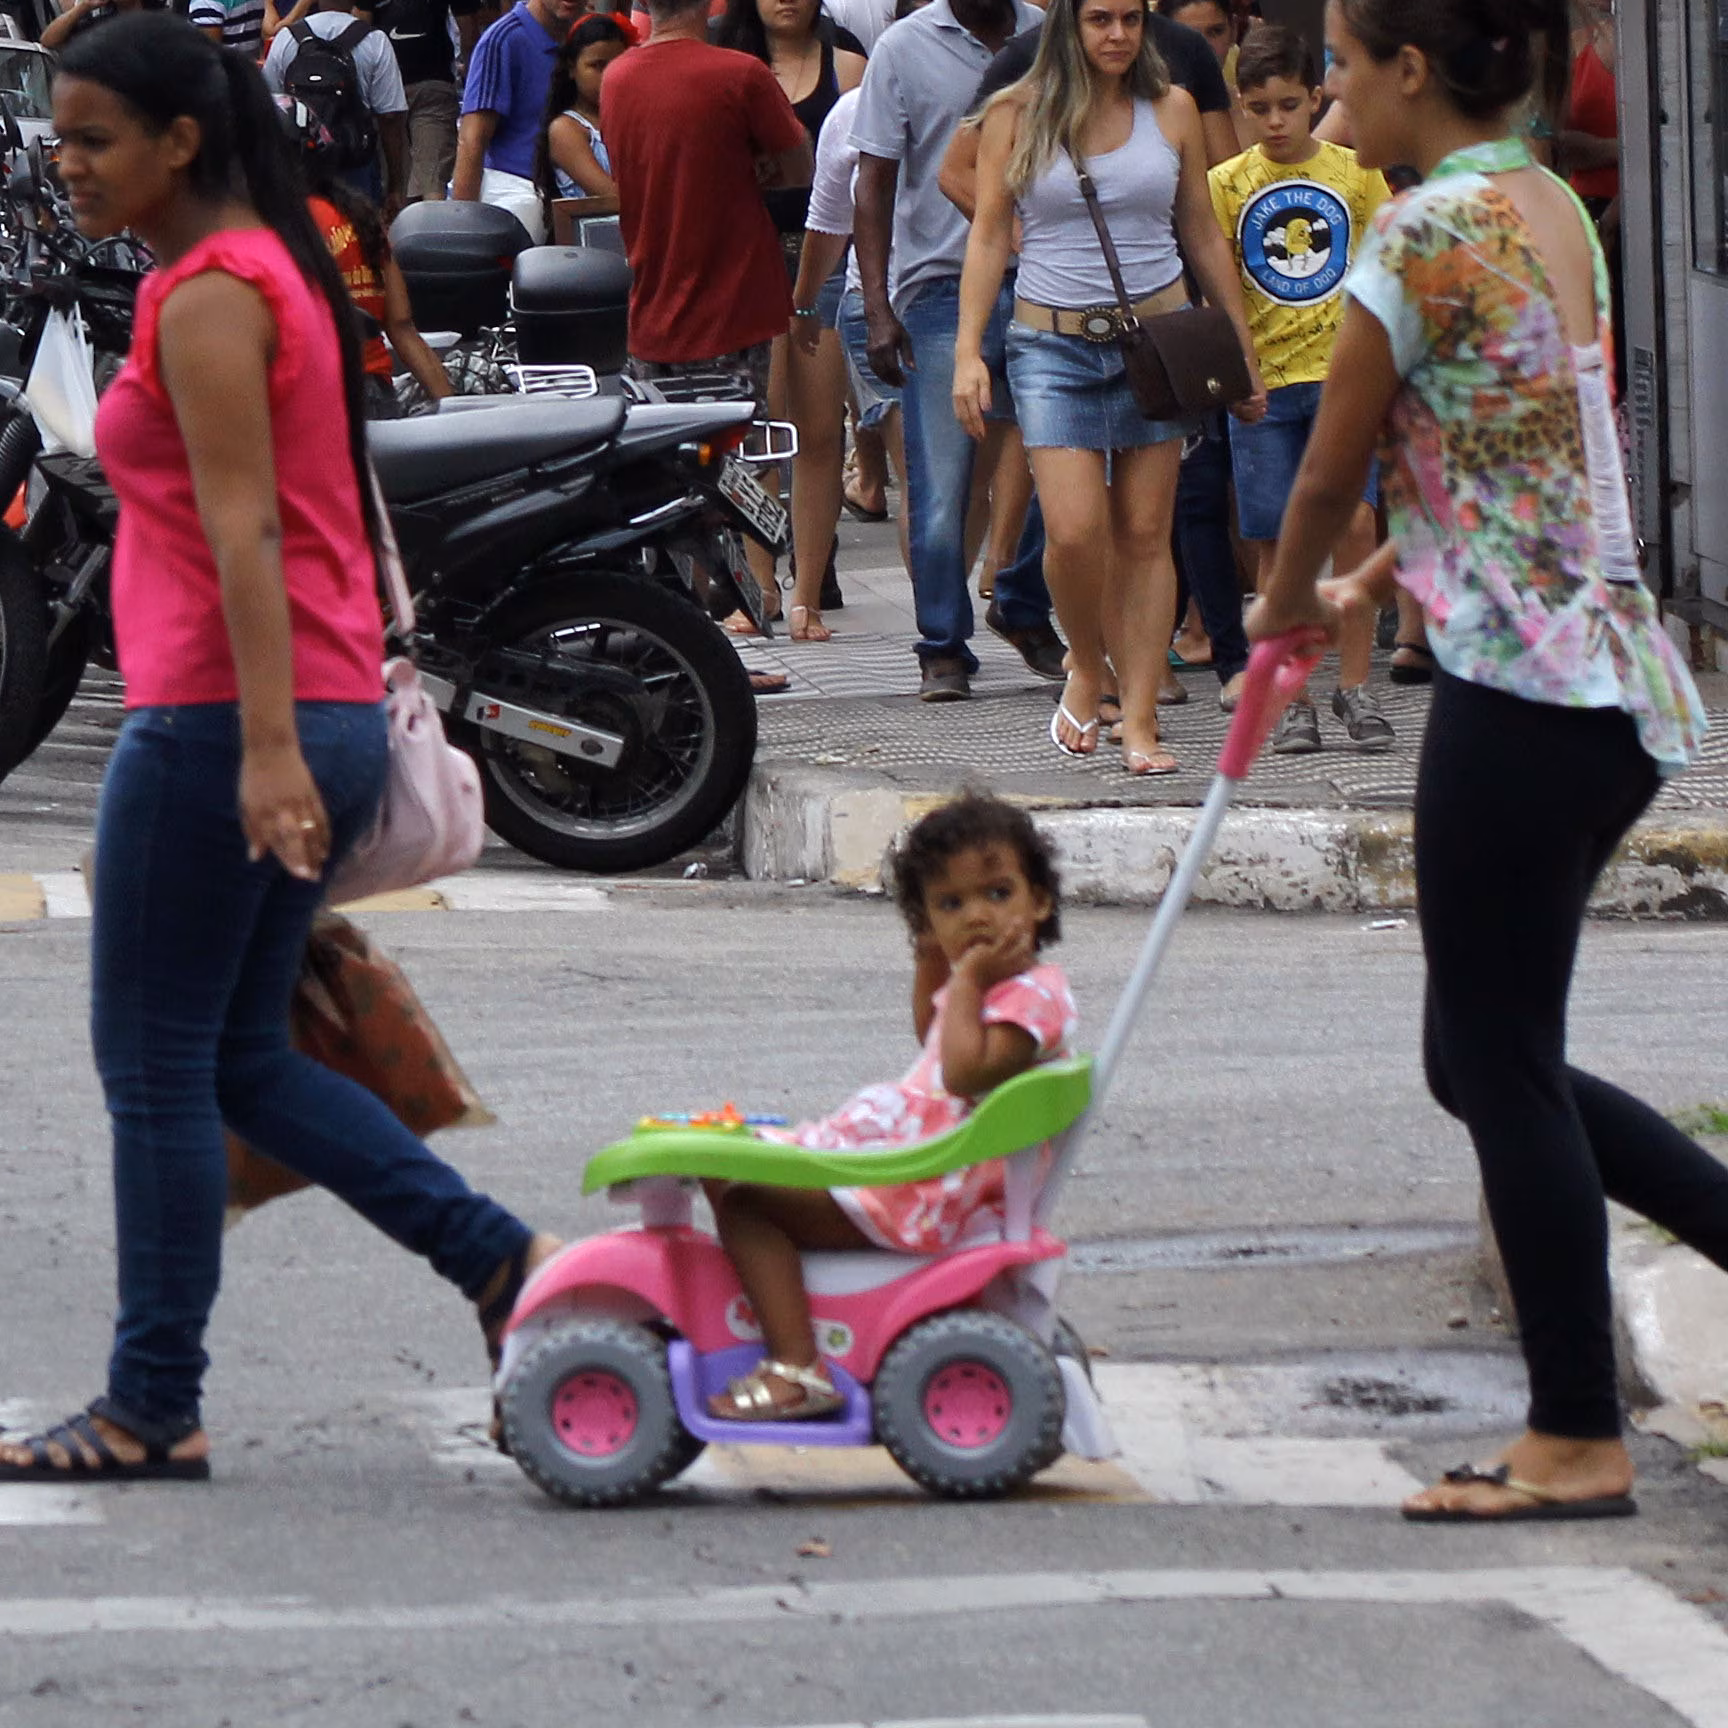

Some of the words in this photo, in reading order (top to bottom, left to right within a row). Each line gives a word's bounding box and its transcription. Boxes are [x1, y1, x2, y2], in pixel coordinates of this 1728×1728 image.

[1251, 197, 1281, 230] JAKE
[1284, 191, 1313, 206] THE
[1316, 198, 1342, 225] DOG
